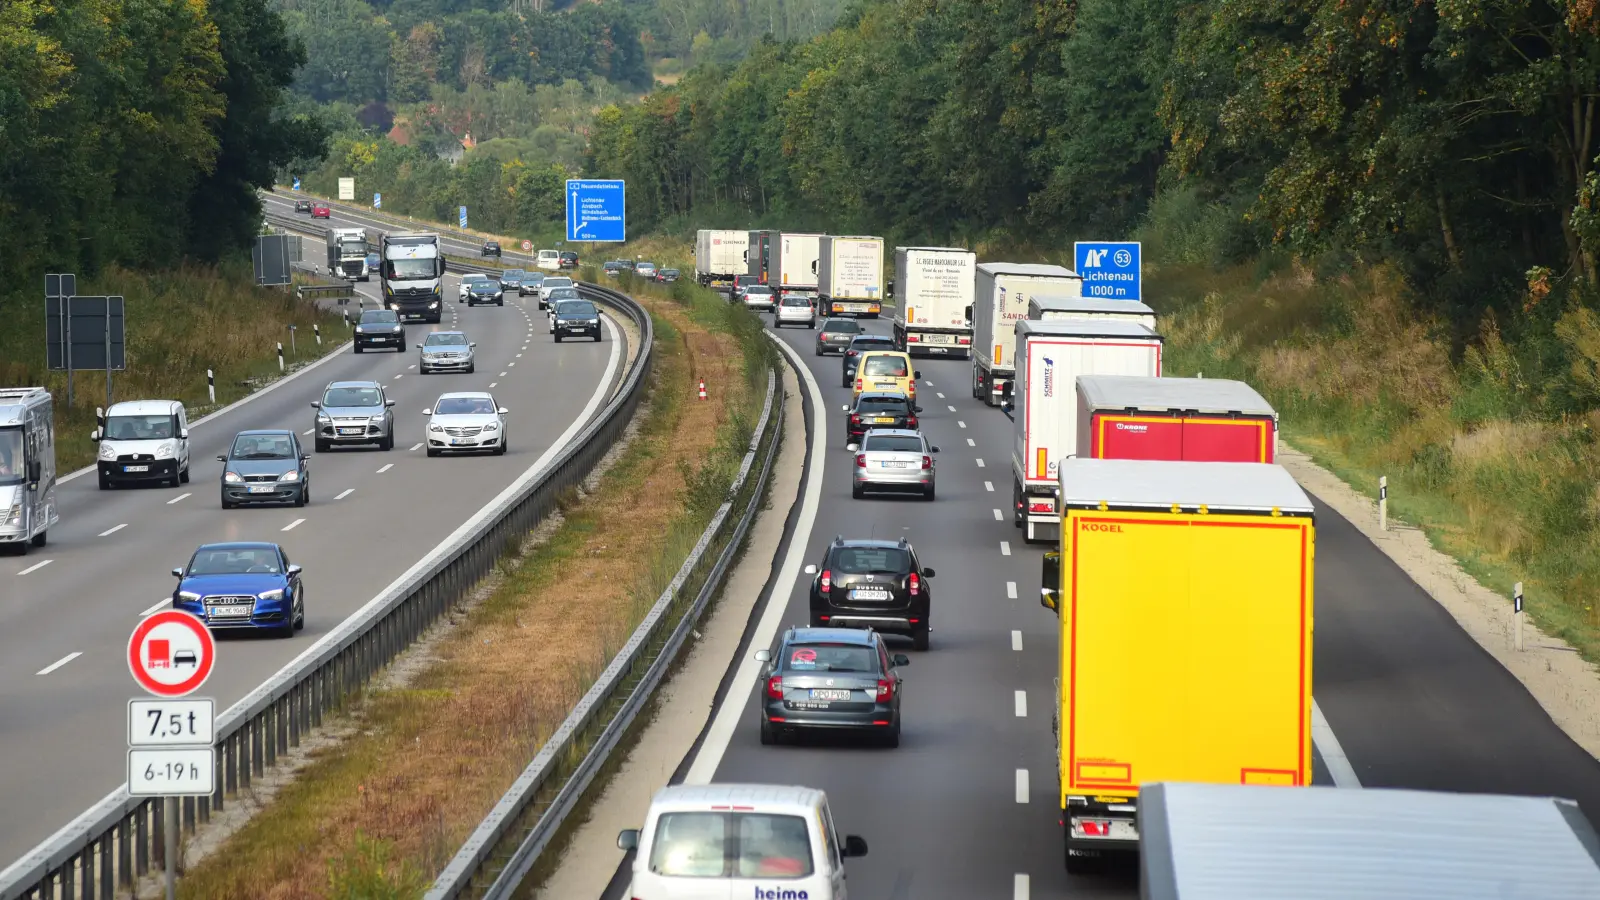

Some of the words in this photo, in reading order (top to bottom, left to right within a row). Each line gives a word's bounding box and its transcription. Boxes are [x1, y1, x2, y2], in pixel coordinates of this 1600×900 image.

[1117, 253, 1130, 263] 53
[1082, 270, 1134, 281] Lichtenau
[1090, 285, 1114, 296] 1000
[1115, 287, 1126, 296] m
[144, 762, 184, 781] 6-19
[190, 763, 199, 780] h
